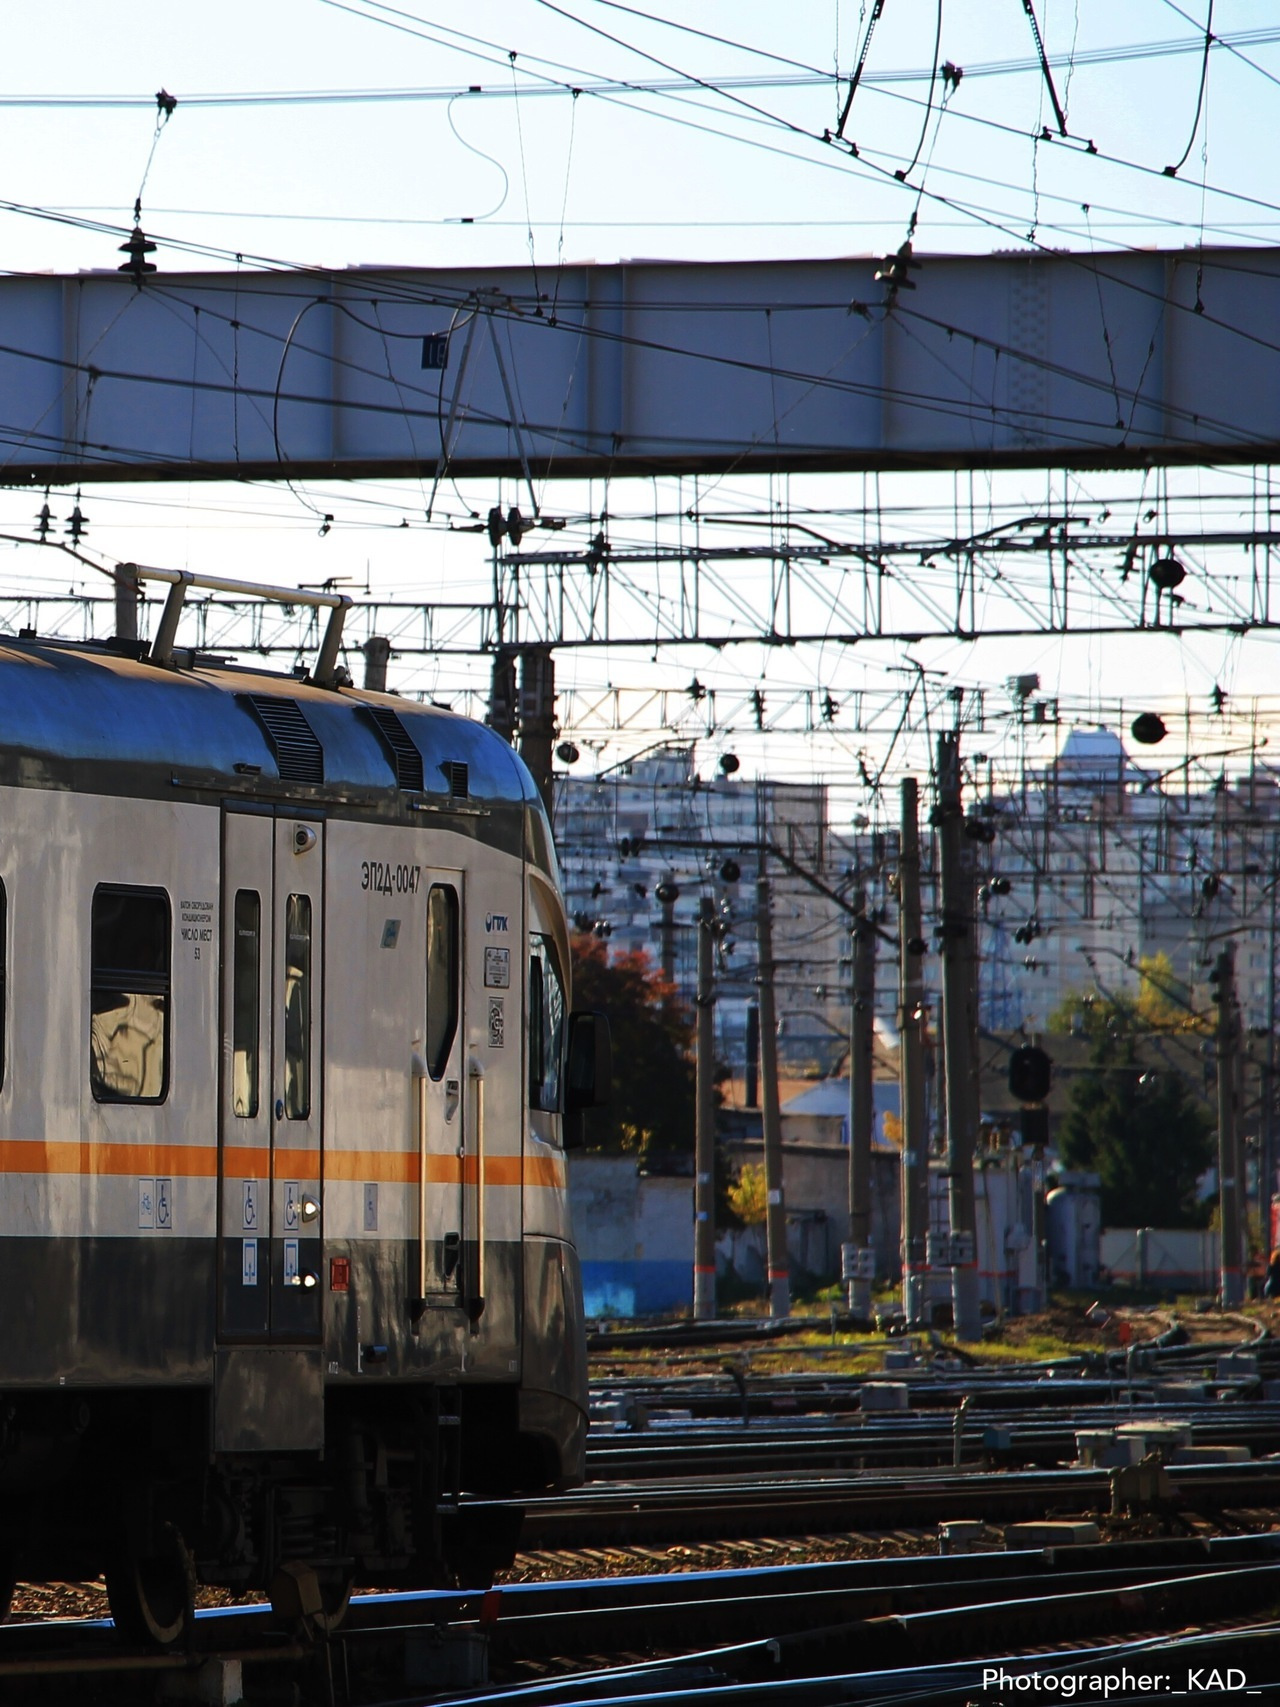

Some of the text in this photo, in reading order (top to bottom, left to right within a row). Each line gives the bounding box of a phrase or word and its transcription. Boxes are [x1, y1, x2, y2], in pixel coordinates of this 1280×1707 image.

[361, 861, 420, 896] ЭП2Д-0047
[181, 928, 212, 941] ЧИСЛО МЕСТ
